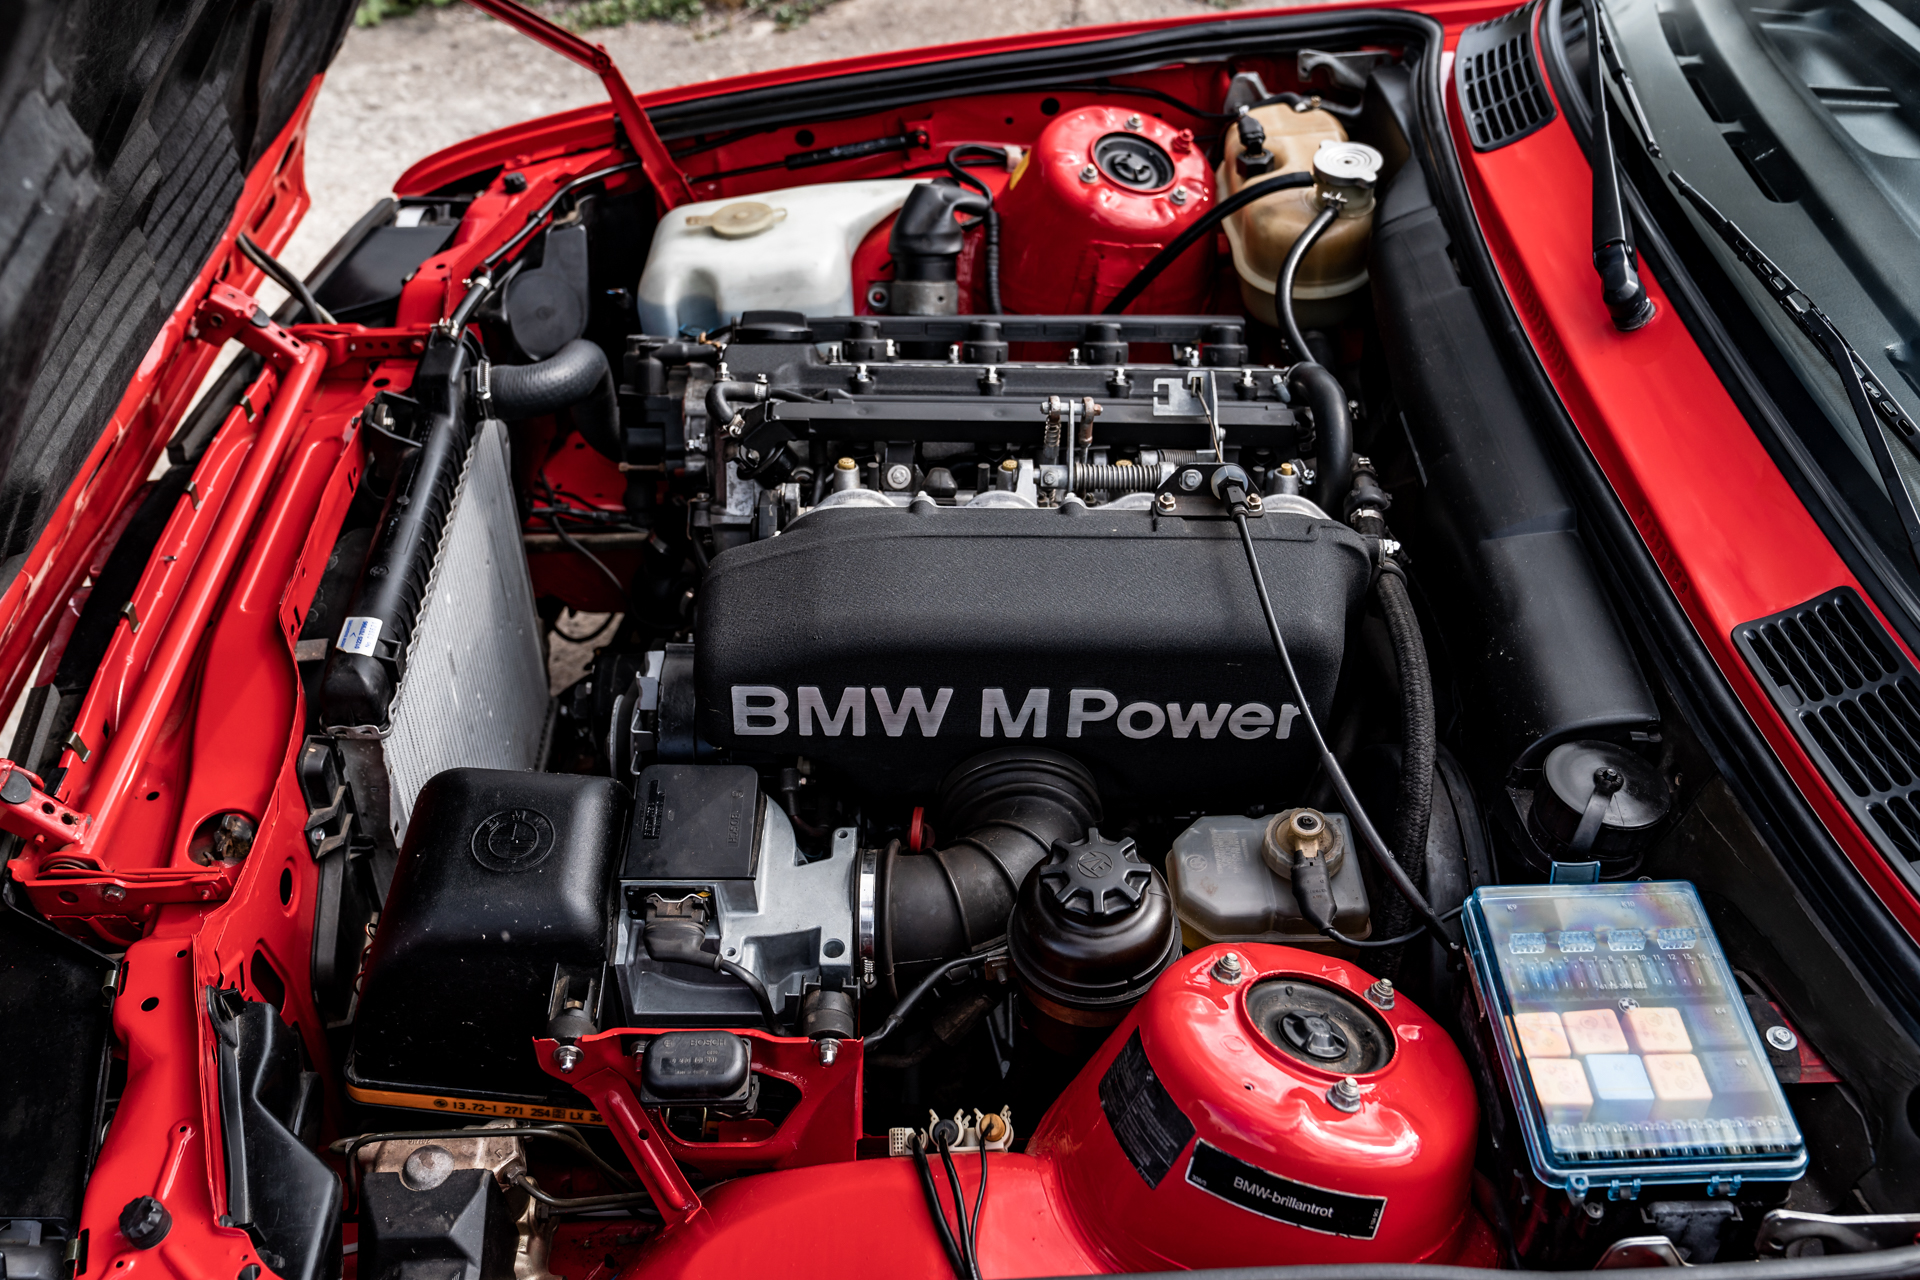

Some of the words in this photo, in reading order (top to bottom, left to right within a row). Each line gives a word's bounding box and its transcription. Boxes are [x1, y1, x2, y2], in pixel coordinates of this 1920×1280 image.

[730, 686, 954, 736] BMW
[980, 688, 1047, 738] M
[1066, 688, 1302, 740] Power
[728, 813, 740, 844] BOSCH
[453, 1102, 496, 1113] 13.72-1
[505, 1106, 523, 1115] 271
[531, 1108, 550, 1117] 254
[570, 1111, 584, 1120] LX
[1233, 1176, 1334, 1218] BMW-brillantrot
